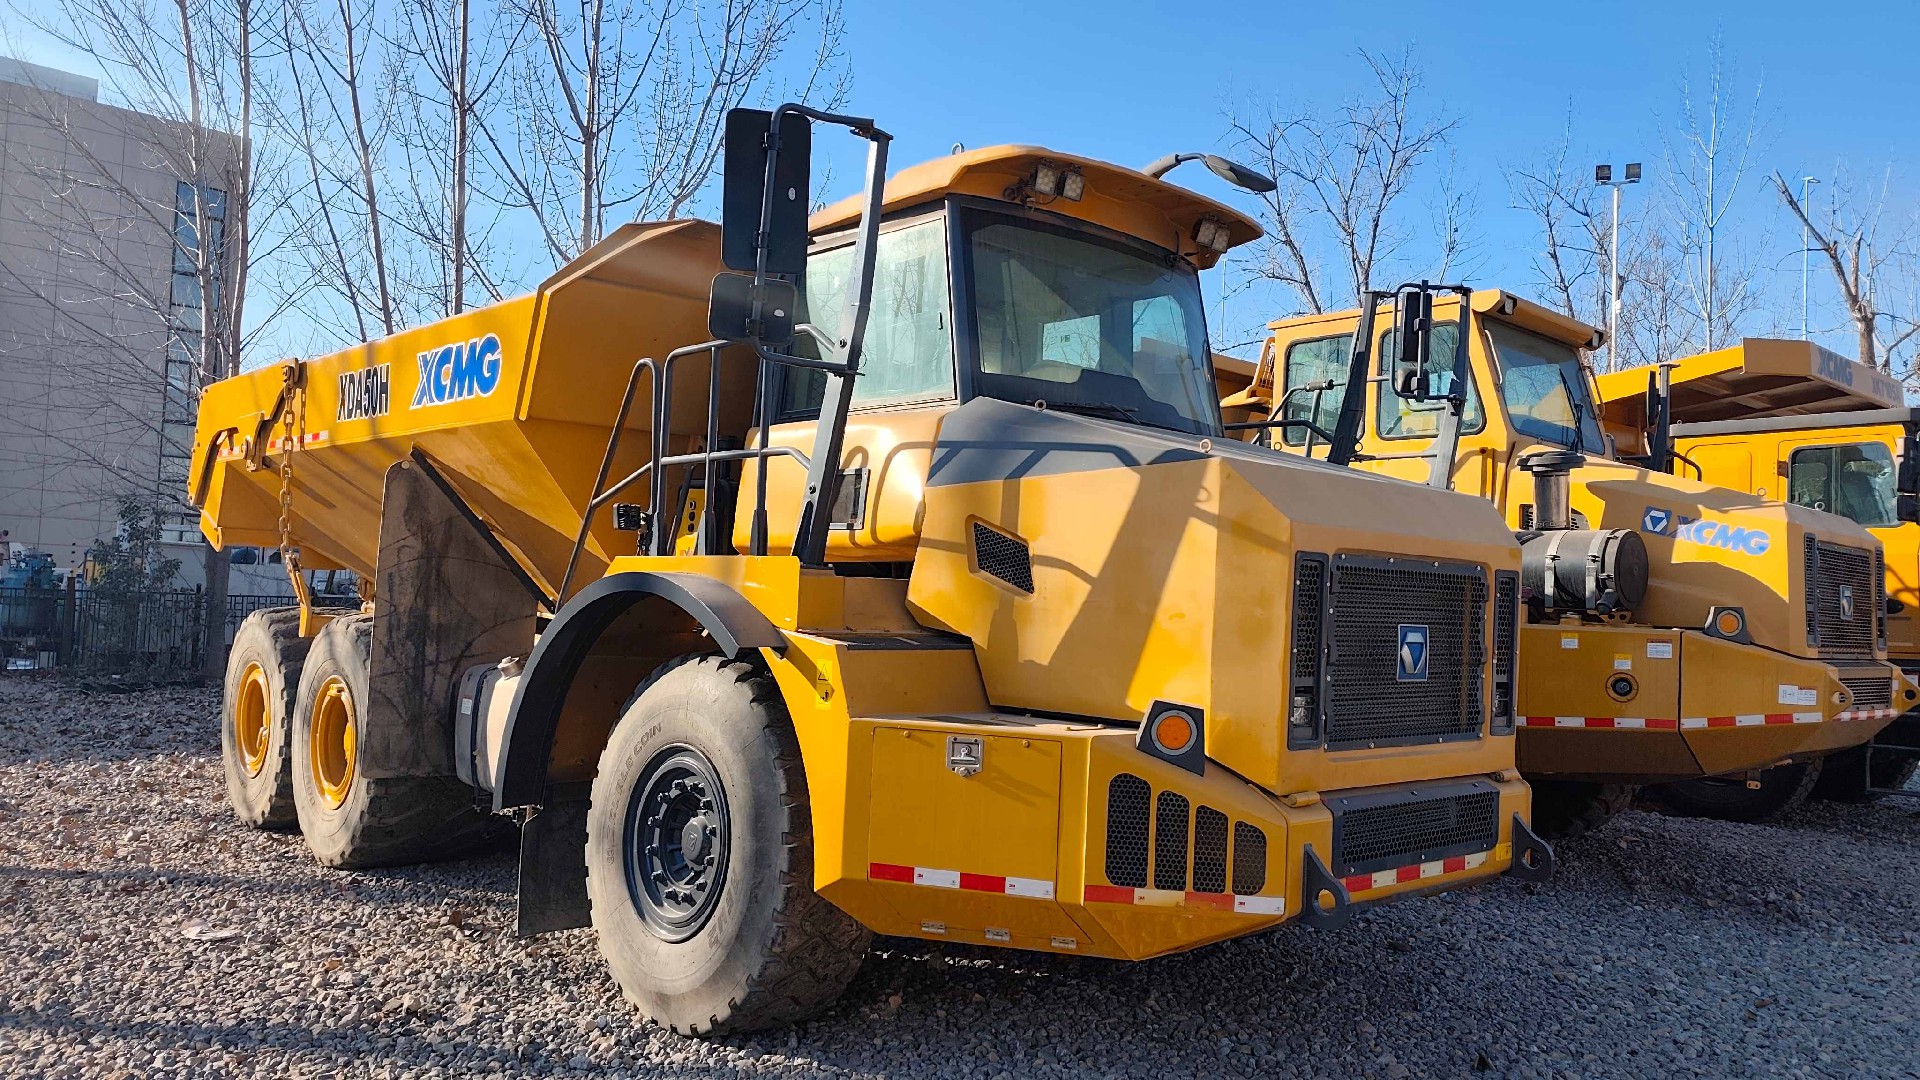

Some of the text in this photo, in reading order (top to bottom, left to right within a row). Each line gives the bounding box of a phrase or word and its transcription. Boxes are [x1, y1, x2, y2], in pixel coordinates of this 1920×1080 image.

[410, 333, 502, 410] XCMG
[1817, 346, 1853, 387] XCMG
[337, 363, 390, 422] XDA50H
[1667, 515, 1770, 556] XCMG
